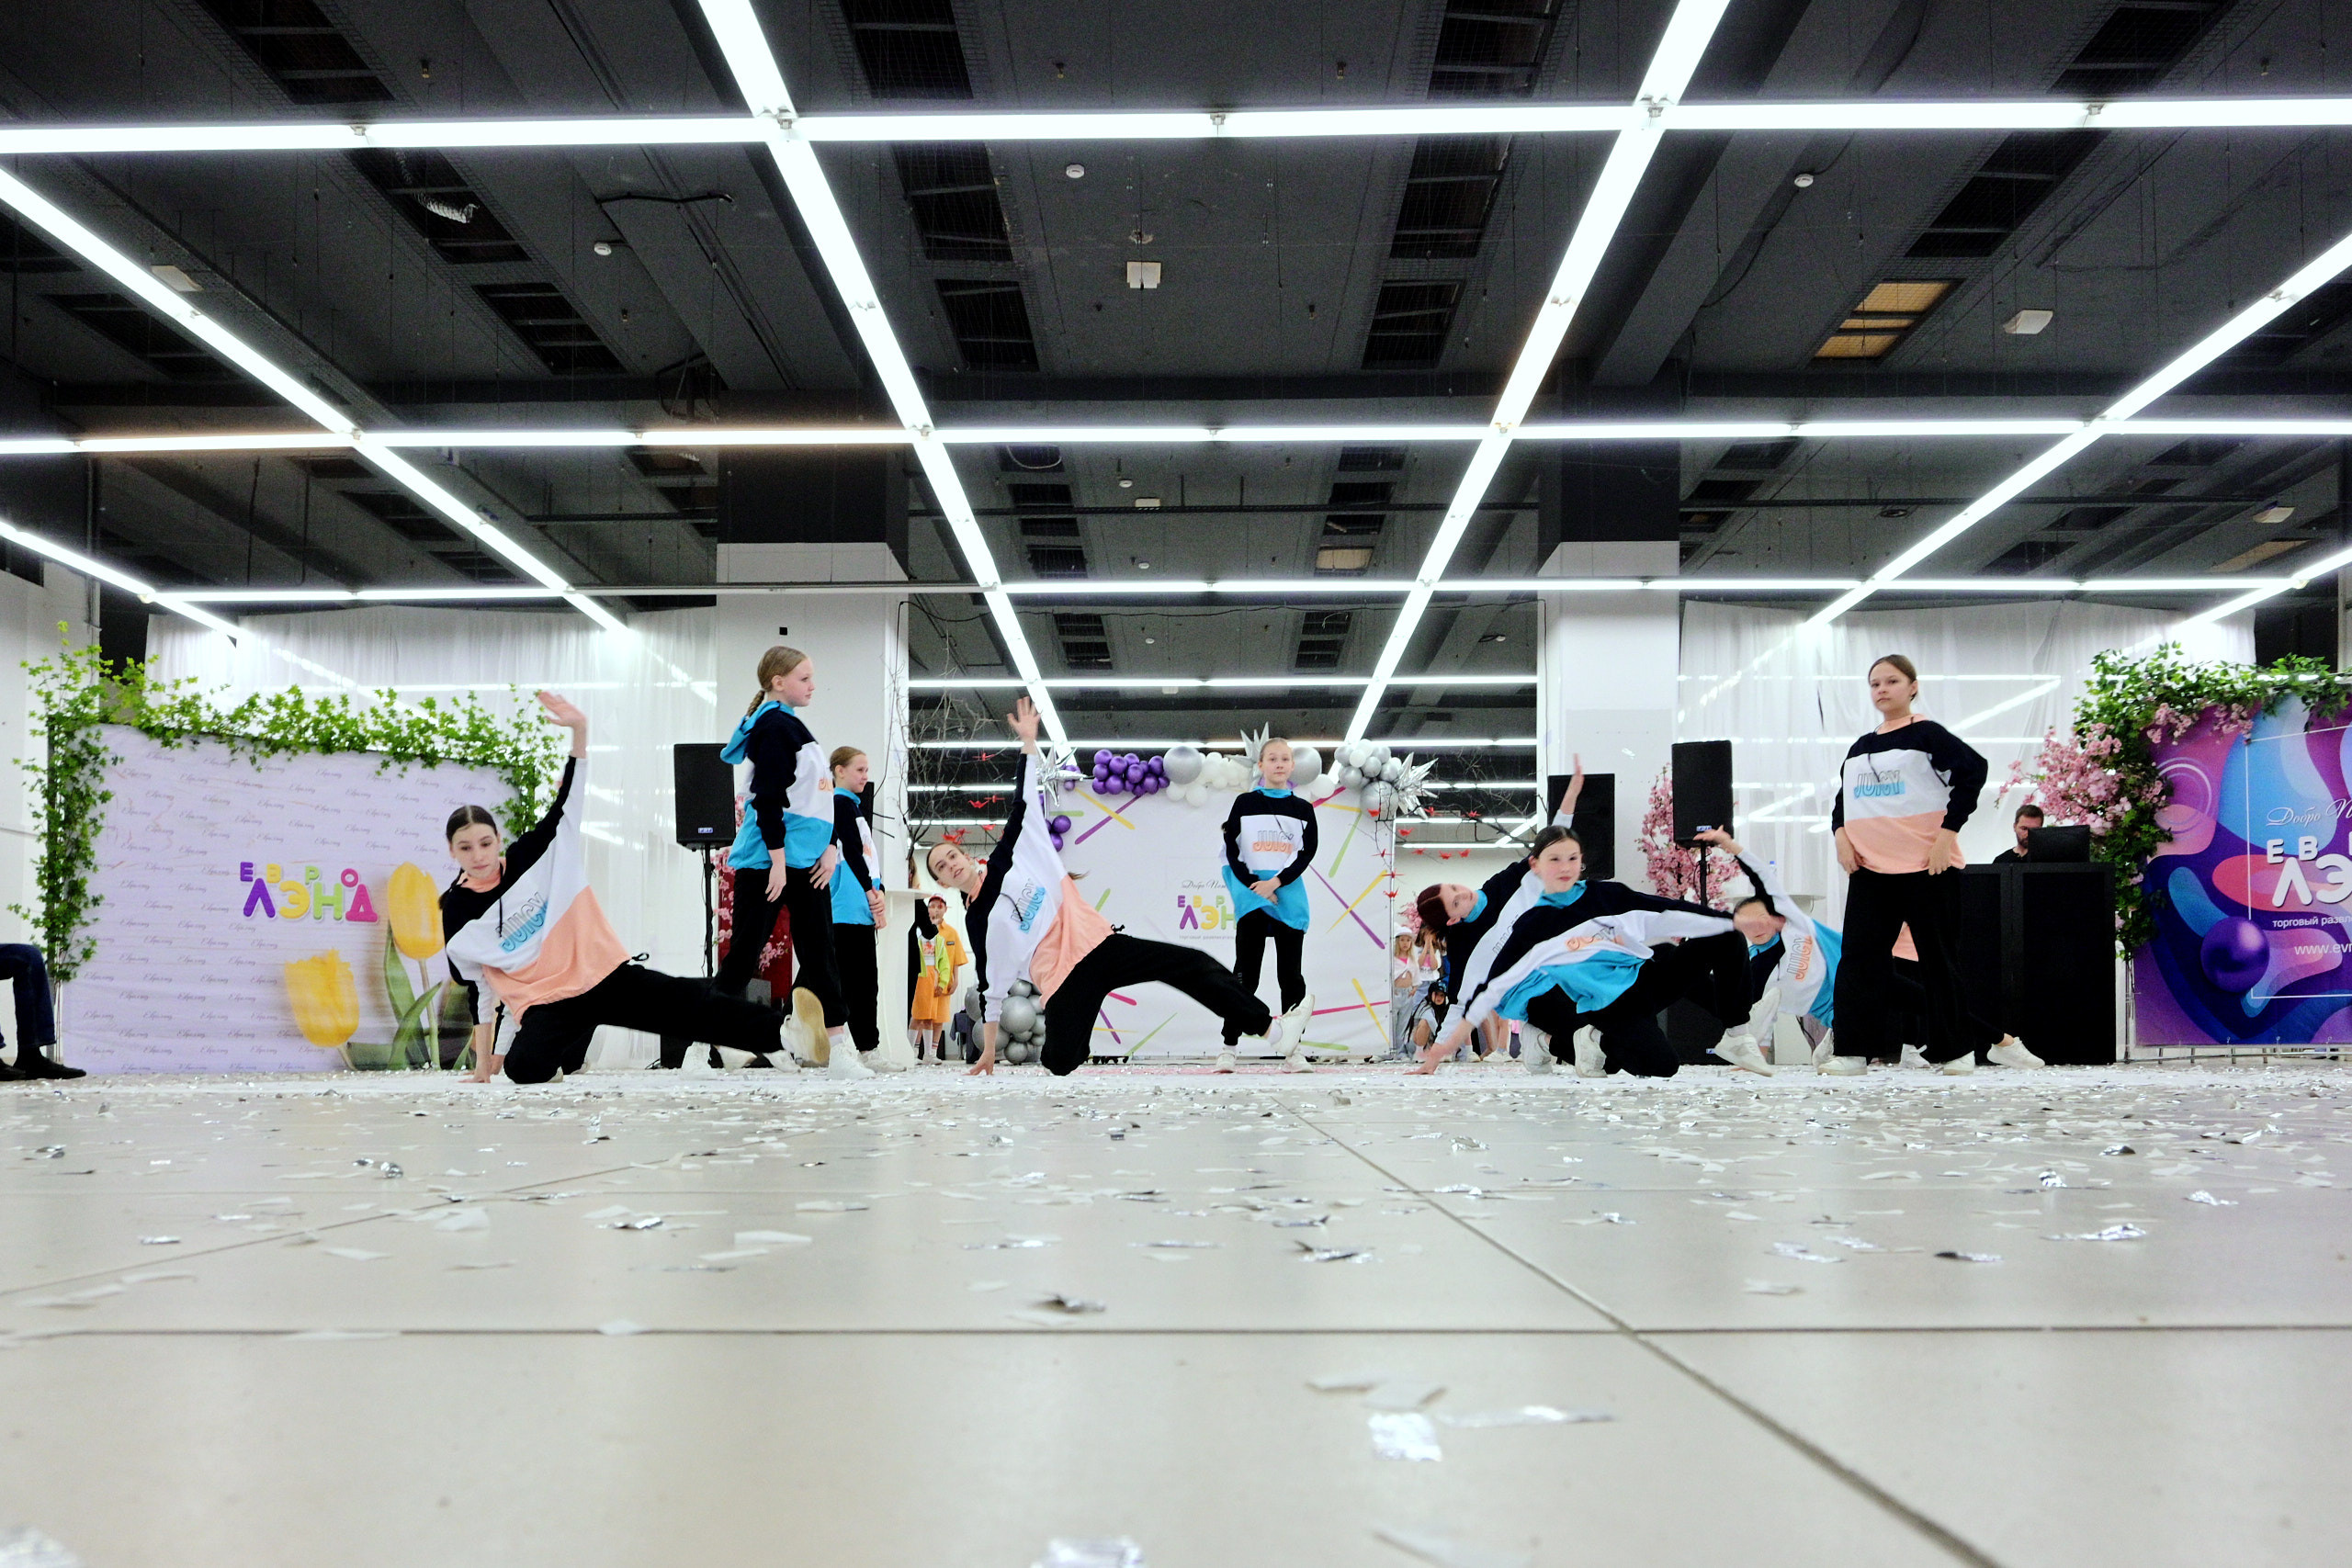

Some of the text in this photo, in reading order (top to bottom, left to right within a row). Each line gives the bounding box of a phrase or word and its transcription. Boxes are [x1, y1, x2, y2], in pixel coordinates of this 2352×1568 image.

[2266, 805, 2322, 828] Добро
[2267, 831, 2352, 864] ЕВ
[2272, 853, 2352, 908] ЛЭ
[243, 877, 379, 923] ЛЭНД
[1178, 895, 1225, 908] ЕВР
[1180, 905, 1237, 930] ЛЭН
[2272, 915, 2352, 930] торговый развл
